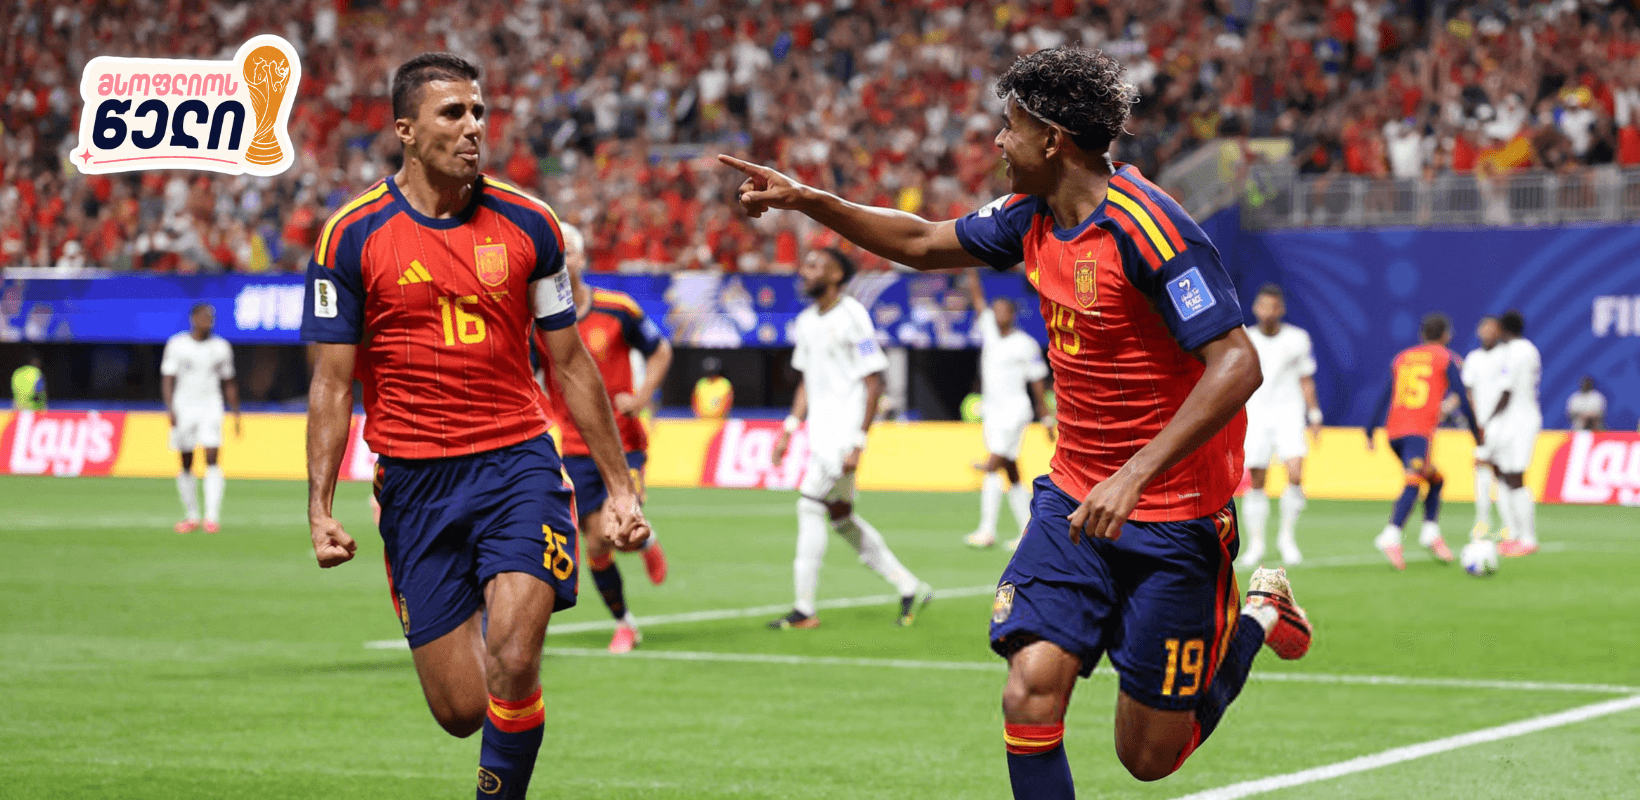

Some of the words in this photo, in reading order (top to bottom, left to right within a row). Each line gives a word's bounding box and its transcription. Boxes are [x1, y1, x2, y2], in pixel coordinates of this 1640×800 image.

[437, 294, 487, 347] 16
[1050, 301, 1081, 356] 19
[1592, 296, 1640, 338] FI
[1396, 364, 1433, 410] 15
[9, 410, 115, 477] Lay's
[715, 420, 812, 490] Lay
[542, 524, 574, 581] 16
[1162, 639, 1204, 696] 19
